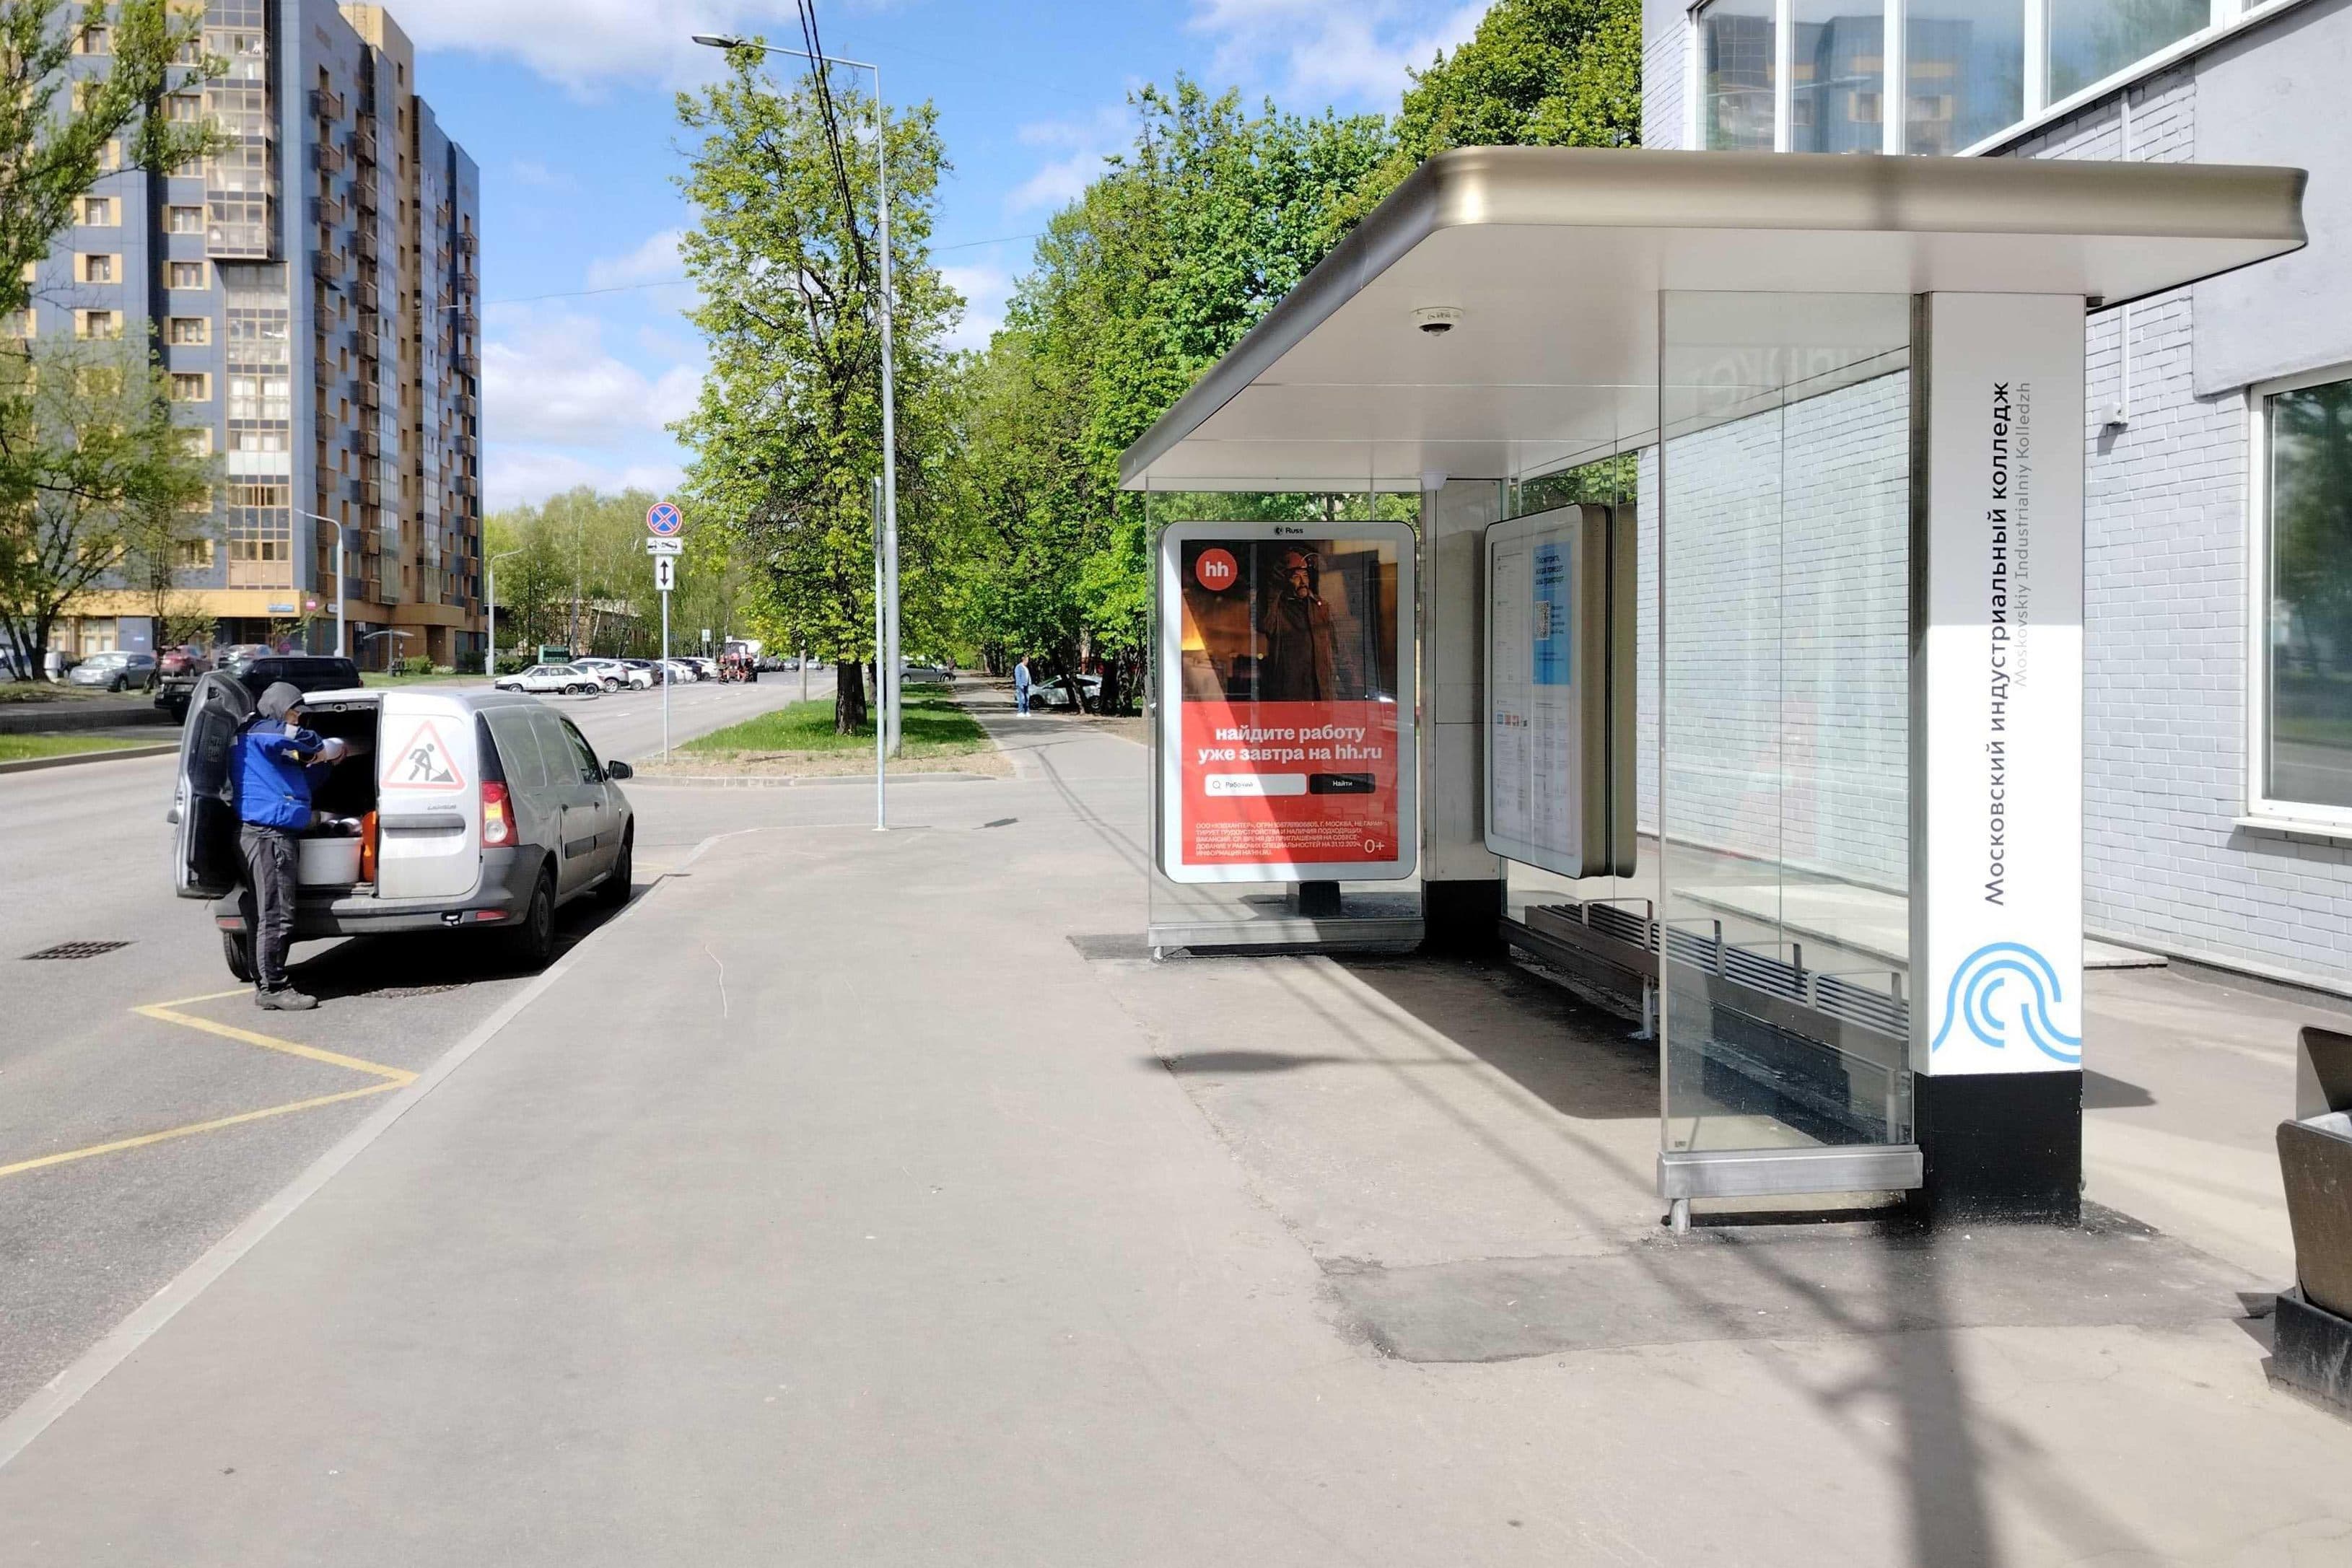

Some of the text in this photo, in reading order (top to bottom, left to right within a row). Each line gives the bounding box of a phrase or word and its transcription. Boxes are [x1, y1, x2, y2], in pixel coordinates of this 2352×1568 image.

[2014, 382, 2032, 687] Moskovskiy Industrialniy Kolledzh
[1205, 561, 1228, 577] hh
[1985, 382, 2011, 906] Московский индустриальный колледж
[1216, 724, 1366, 743] найдите работу
[1198, 744, 1382, 765] уже завтра на hh.ru
[1364, 838, 1385, 853] 0+
